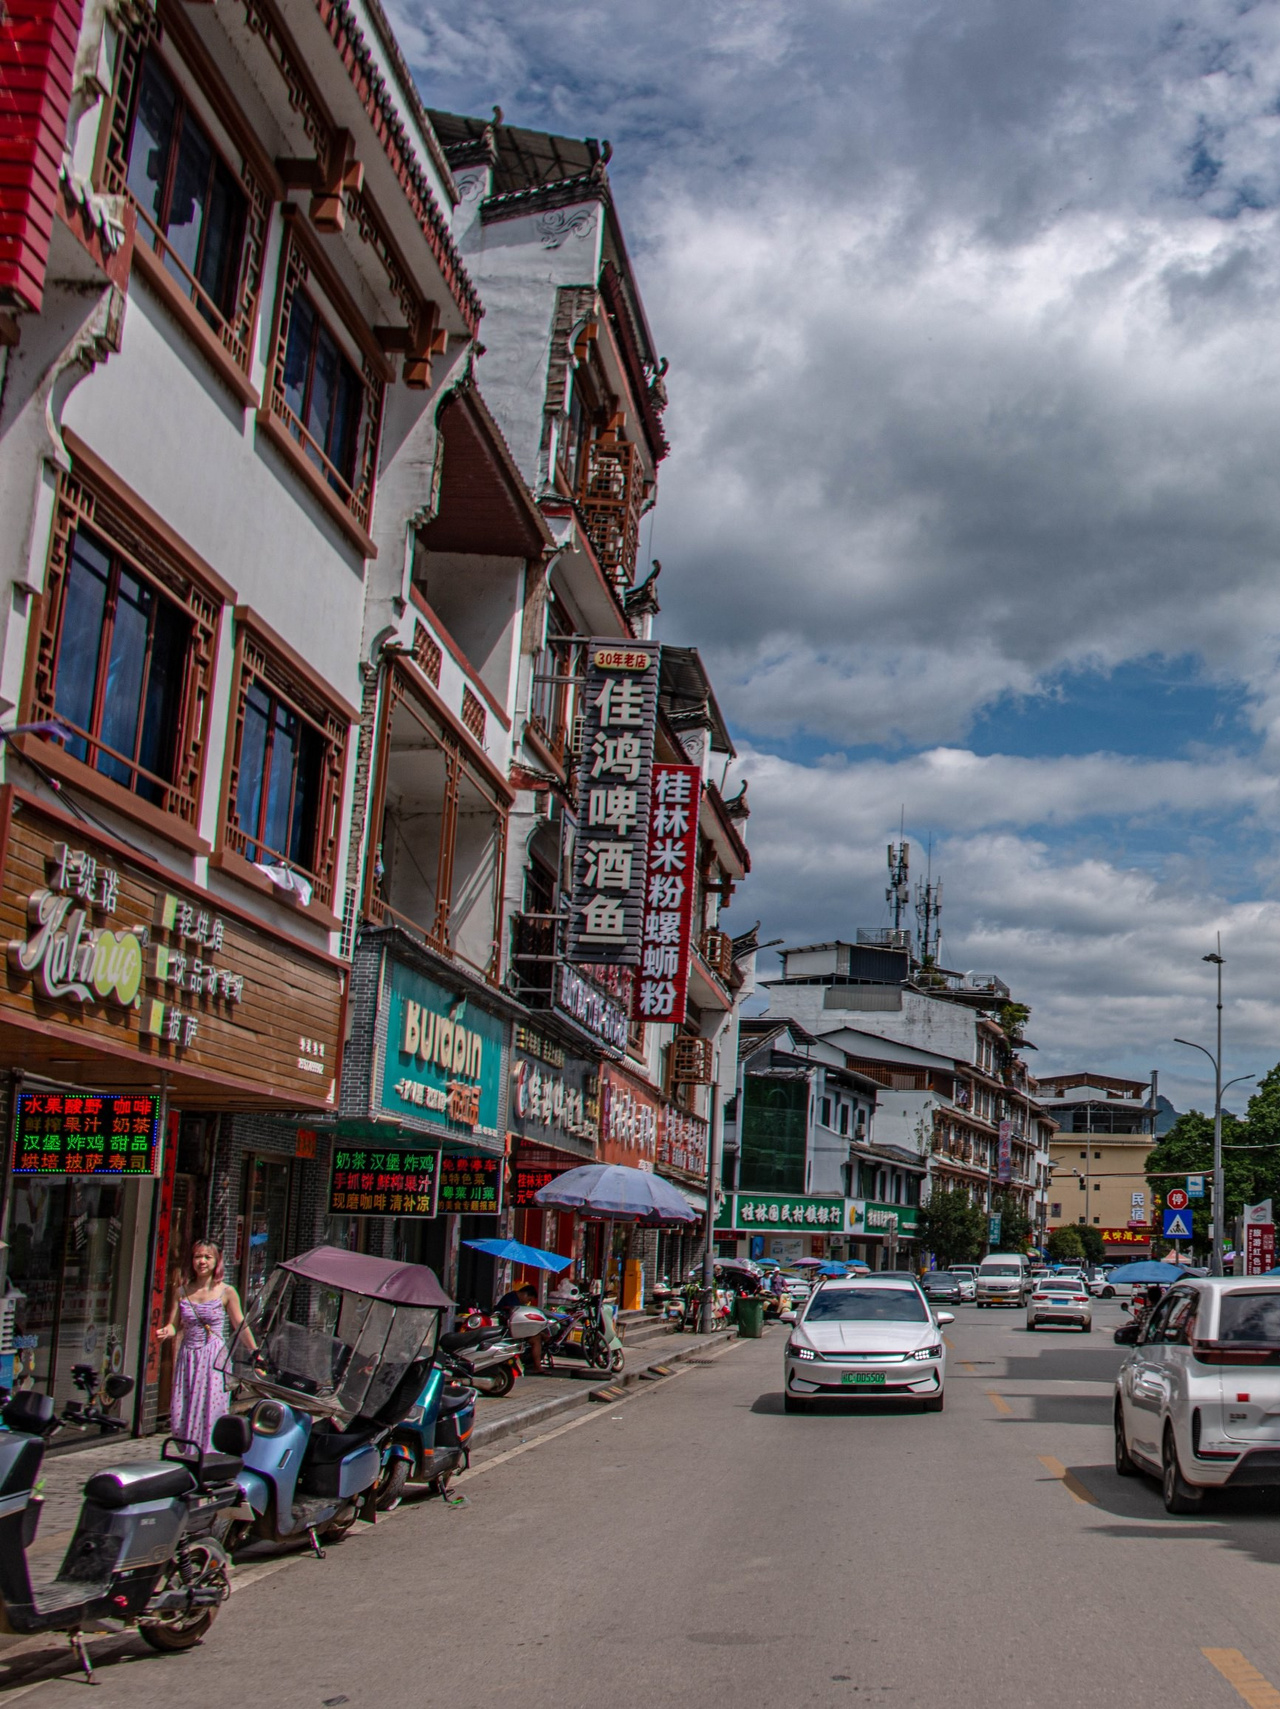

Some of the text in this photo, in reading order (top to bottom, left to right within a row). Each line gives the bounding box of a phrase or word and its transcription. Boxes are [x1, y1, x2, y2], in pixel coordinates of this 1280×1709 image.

[598, 652, 647, 669] 30年老店
[578, 679, 644, 944] 佳鸿啤酒鱼
[639, 770, 692, 1017] 桂林米粉螺蛳粉
[25, 1098, 152, 1114] 水果酸野 咖啡
[24, 1117, 151, 1133] 鲜榨果汁 奶茶
[23, 1134, 148, 1151] 汉堡 炸鸡 甜品
[65, 1153, 103, 1170] 披萨
[109, 1154, 146, 1170] 寿司
[335, 1151, 434, 1173] 奶茶 汉堡 炸鸡
[333, 1172, 432, 1193] 手抓饼 鲜榨果汁
[470, 1187, 495, 1200] 川菜
[1172, 1193, 1184, 1206] 停
[332, 1193, 430, 1212] 现磨咖啡 清补凉
